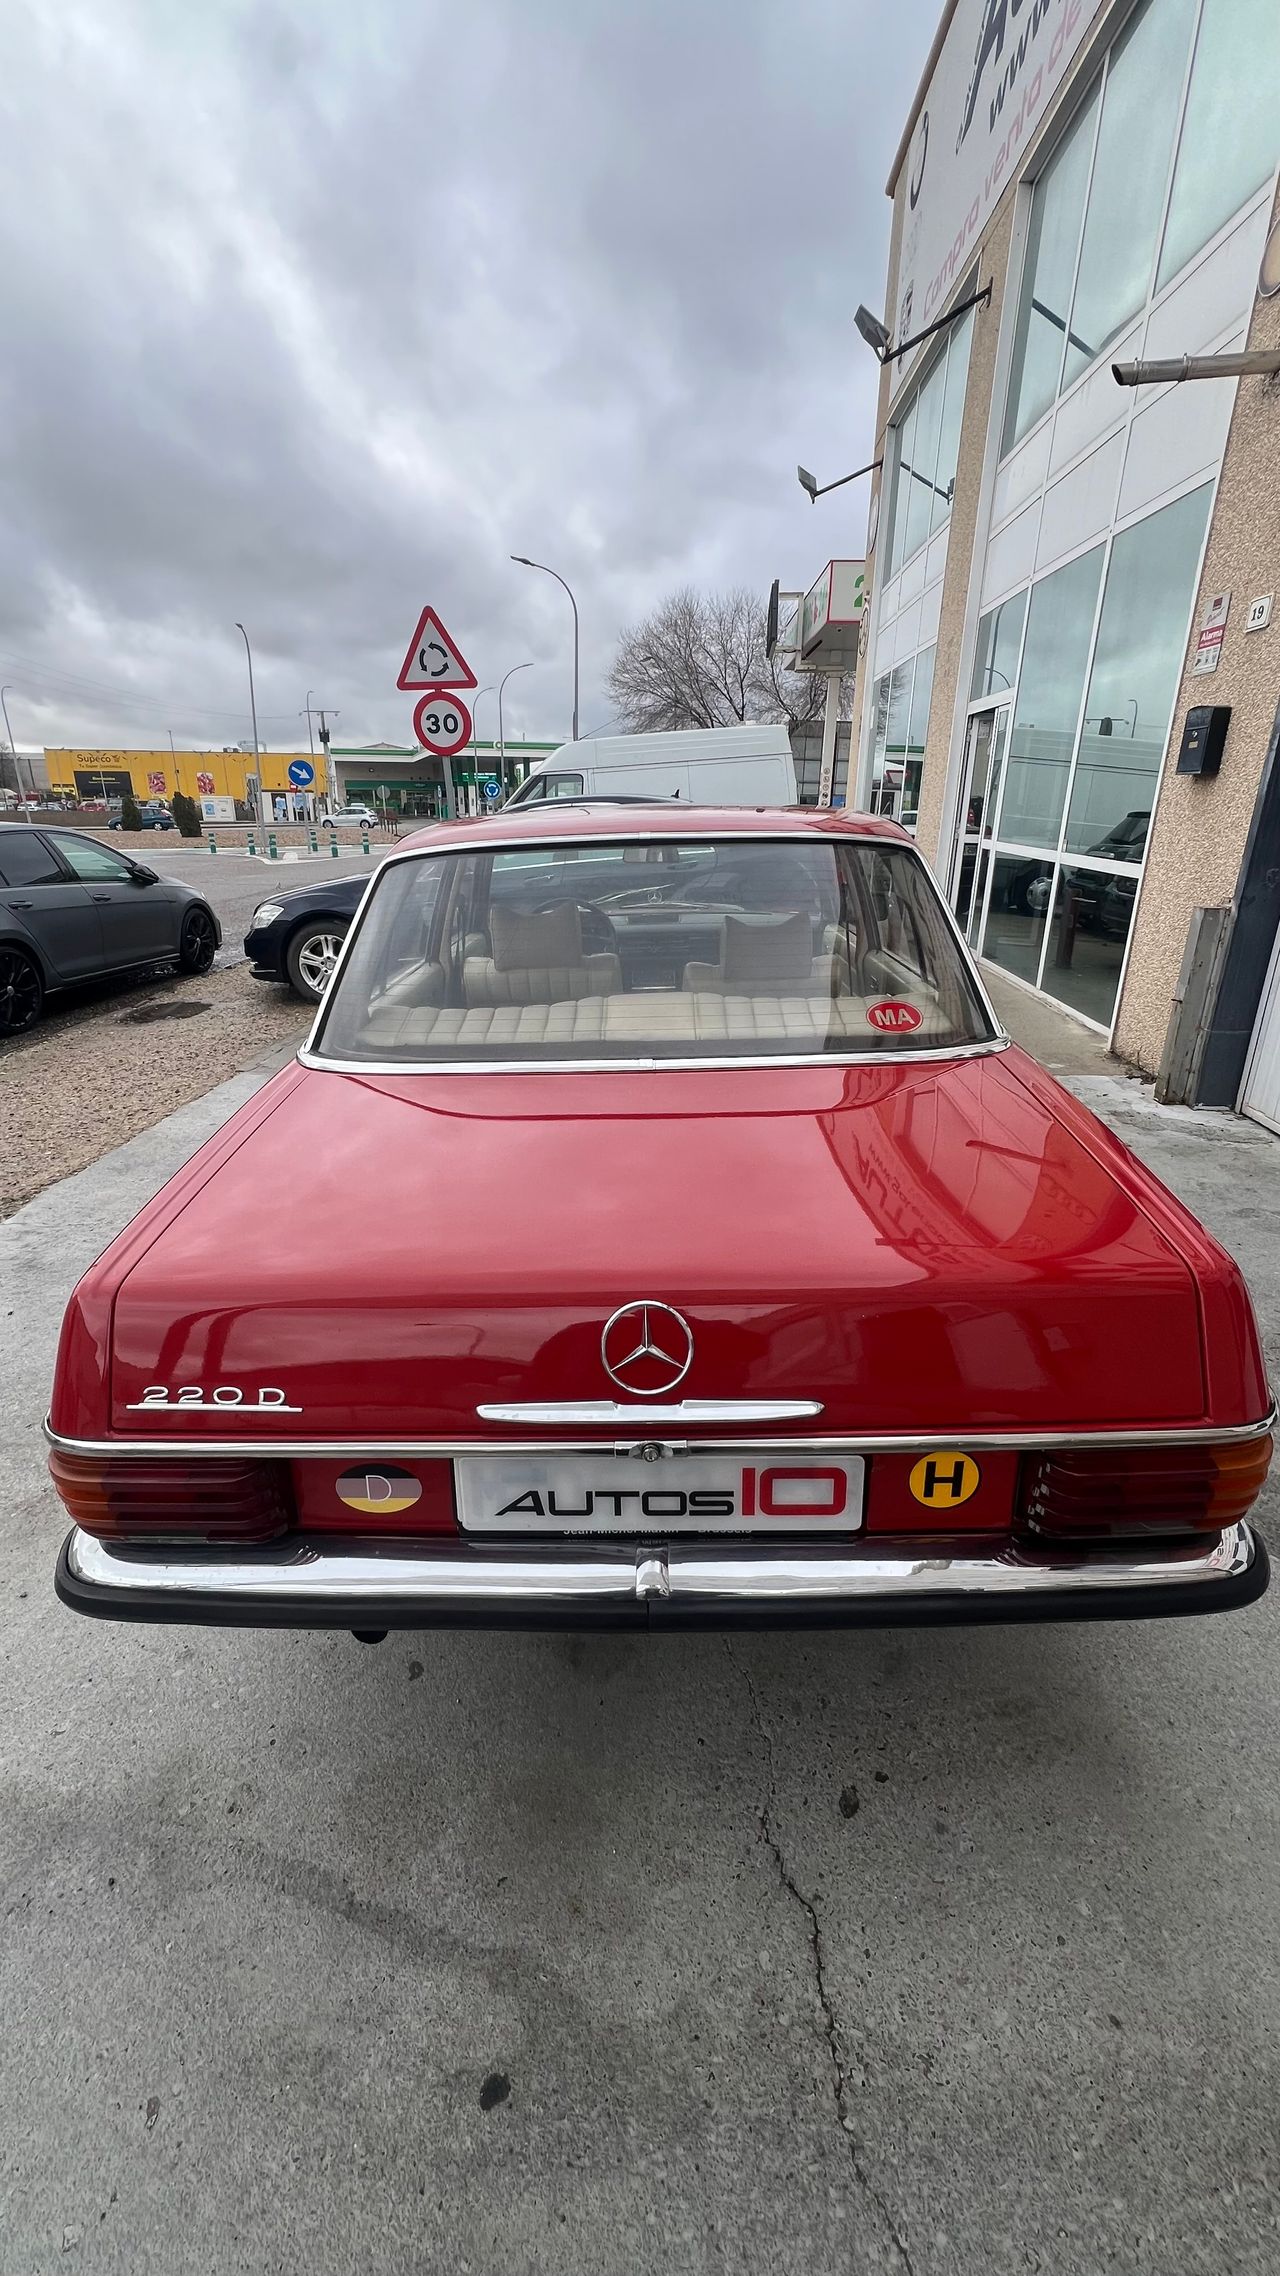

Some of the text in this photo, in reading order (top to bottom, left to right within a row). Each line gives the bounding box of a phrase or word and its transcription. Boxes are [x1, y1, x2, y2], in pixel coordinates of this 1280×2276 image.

[985, 63, 1044, 202] venta
[1251, 605, 1265, 622] 19
[1201, 629, 1223, 642] Alarma
[426, 713, 459, 734] 30
[77, 753, 111, 763] Supeco
[874, 1008, 916, 1026] MA
[143, 1386, 286, 1407] 220 D
[365, 1475, 392, 1502] D
[923, 1460, 965, 1498] H
